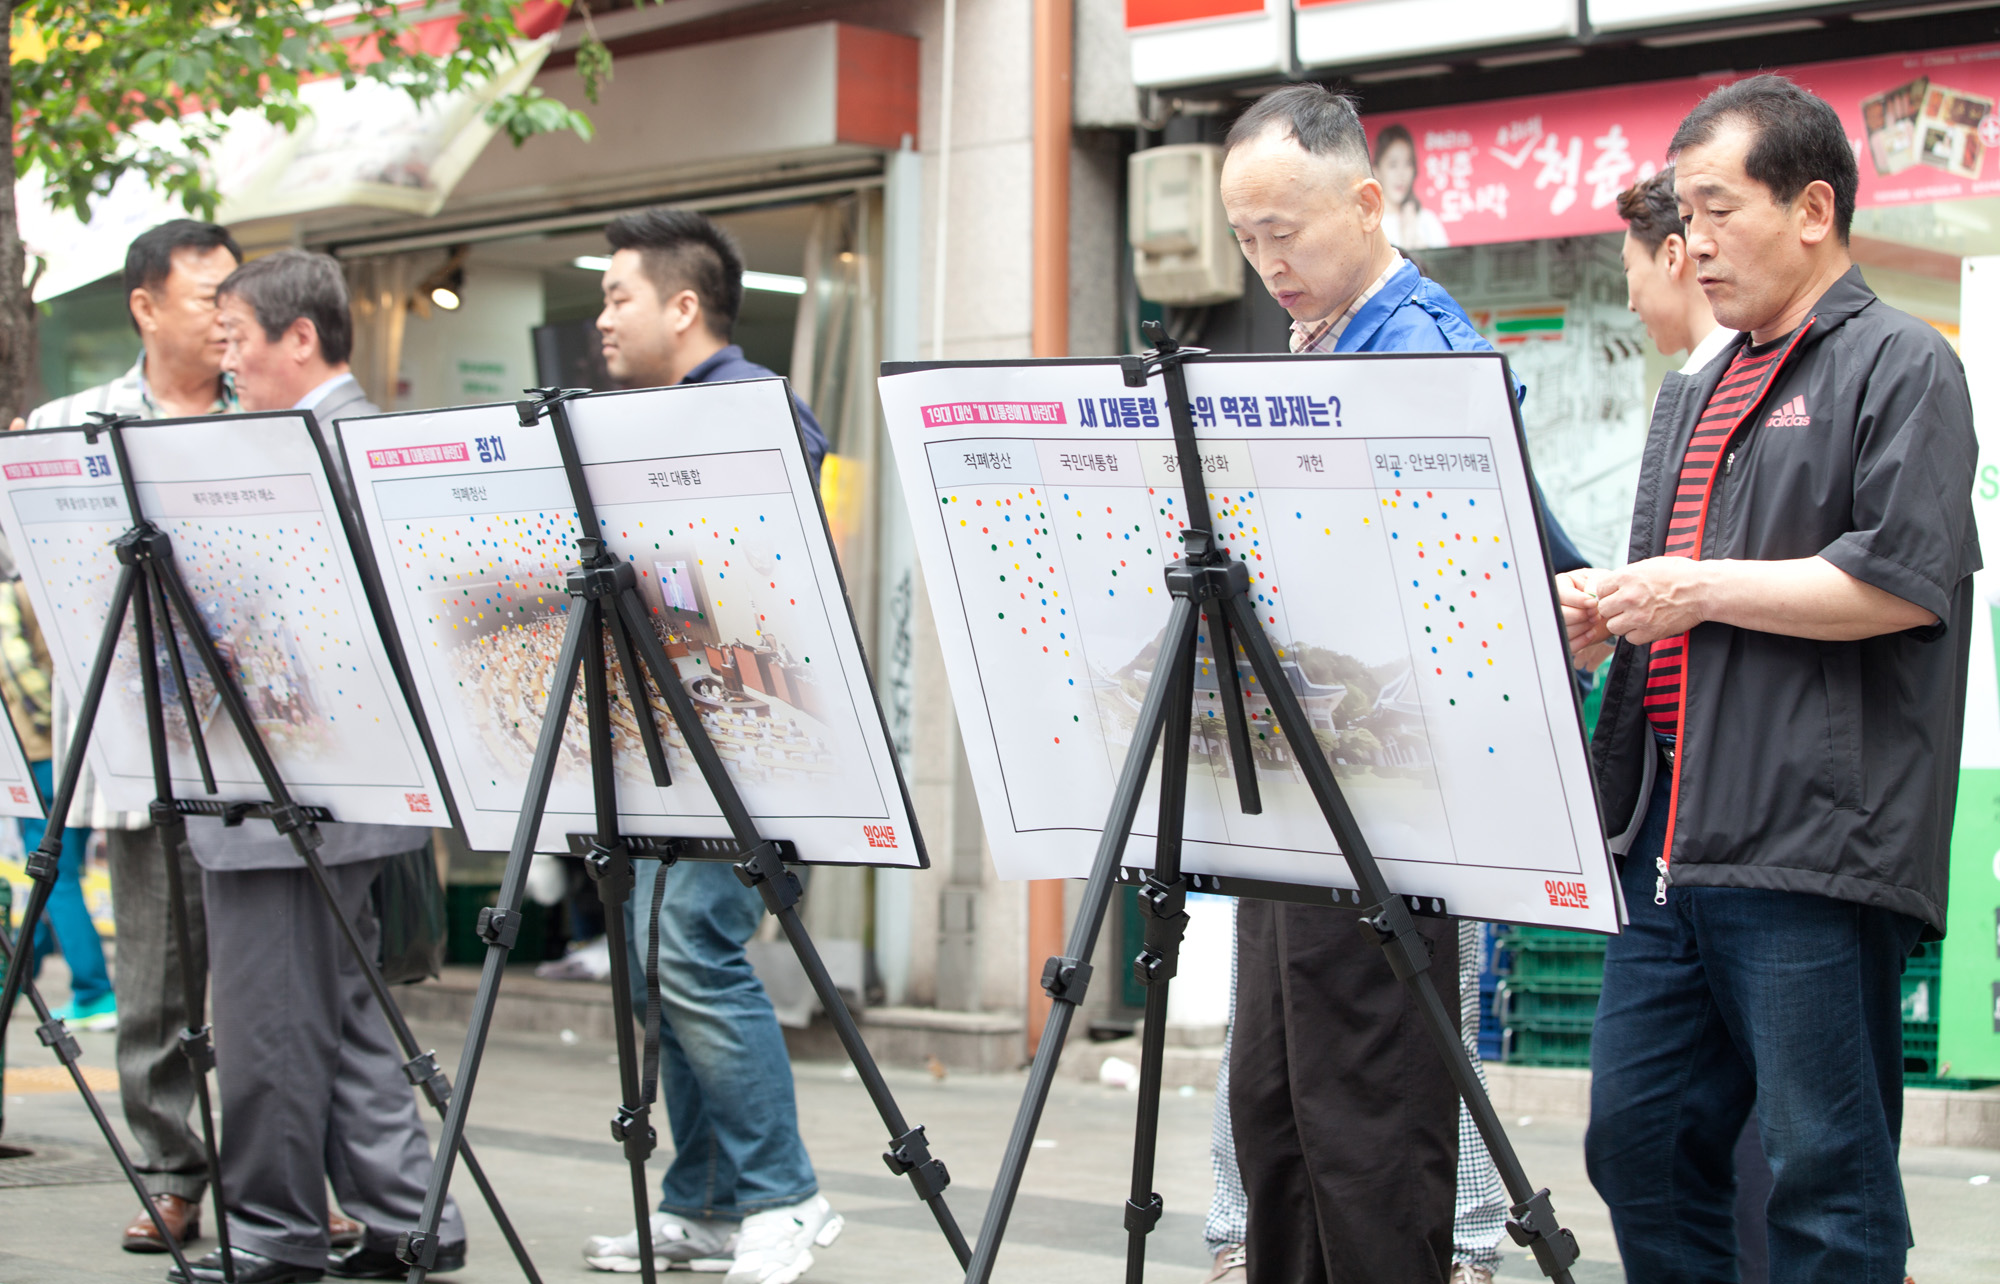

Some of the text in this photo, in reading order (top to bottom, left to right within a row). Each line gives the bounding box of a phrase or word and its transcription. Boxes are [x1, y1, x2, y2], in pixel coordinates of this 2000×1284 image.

[927, 407, 951, 423] 19대
[952, 405, 974, 422] 대선
[989, 404, 1032, 421] 대통령에게
[1078, 398, 1098, 428] 새
[1099, 397, 1160, 428] 대통령
[1219, 396, 1262, 427] 역점
[1264, 395, 1343, 427] 과제는?
[1765, 413, 1811, 428] adidas
[475, 435, 506, 463] 정치
[963, 452, 1012, 470] 적폐청산
[1059, 453, 1119, 472] 국민대통합
[1162, 454, 1229, 473] 경성화
[1296, 454, 1325, 473] 개헌
[1375, 453, 1491, 473] 외교·안보위기해결
[648, 469, 702, 488] 국민 대통합
[451, 486, 488, 502] 적폐청산
[863, 825, 898, 849] 일요신문
[1544, 880, 1590, 910] 일요신문
